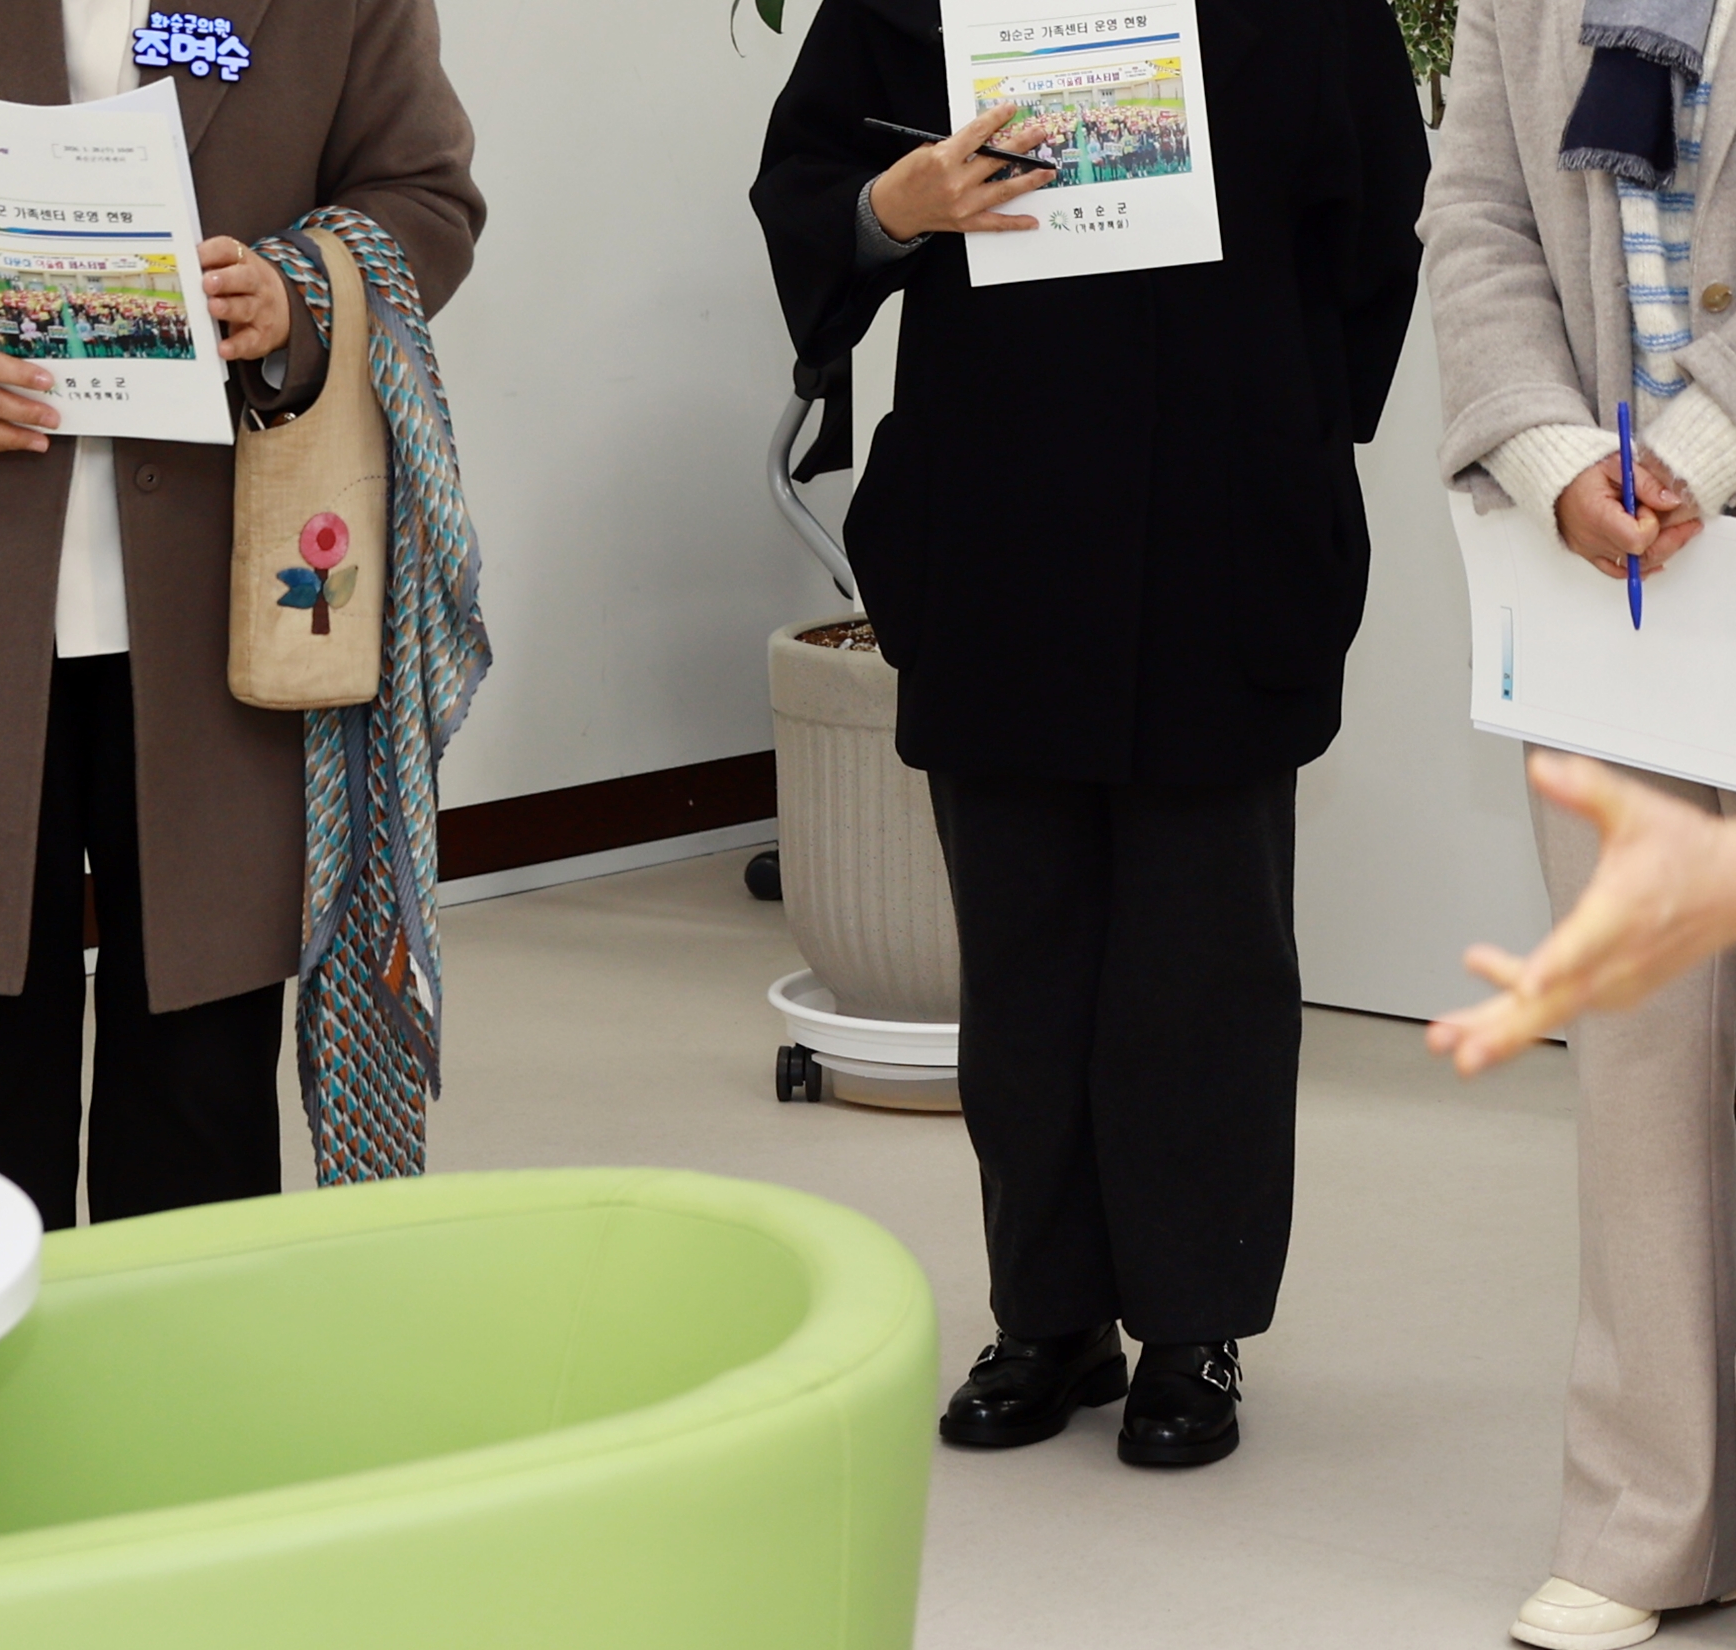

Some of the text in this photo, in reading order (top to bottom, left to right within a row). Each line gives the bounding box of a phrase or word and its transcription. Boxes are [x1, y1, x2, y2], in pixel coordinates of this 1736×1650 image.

[150, 11, 231, 38] 화순군의원
[999, 14, 1148, 43] 화순군 가족센터 운영 현황
[133, 28, 251, 82] 조명순
[14, 203, 66, 223] 가족센터
[72, 206, 100, 223] 운영
[106, 207, 134, 224] 현황
[1073, 202, 1128, 220] 화순군
